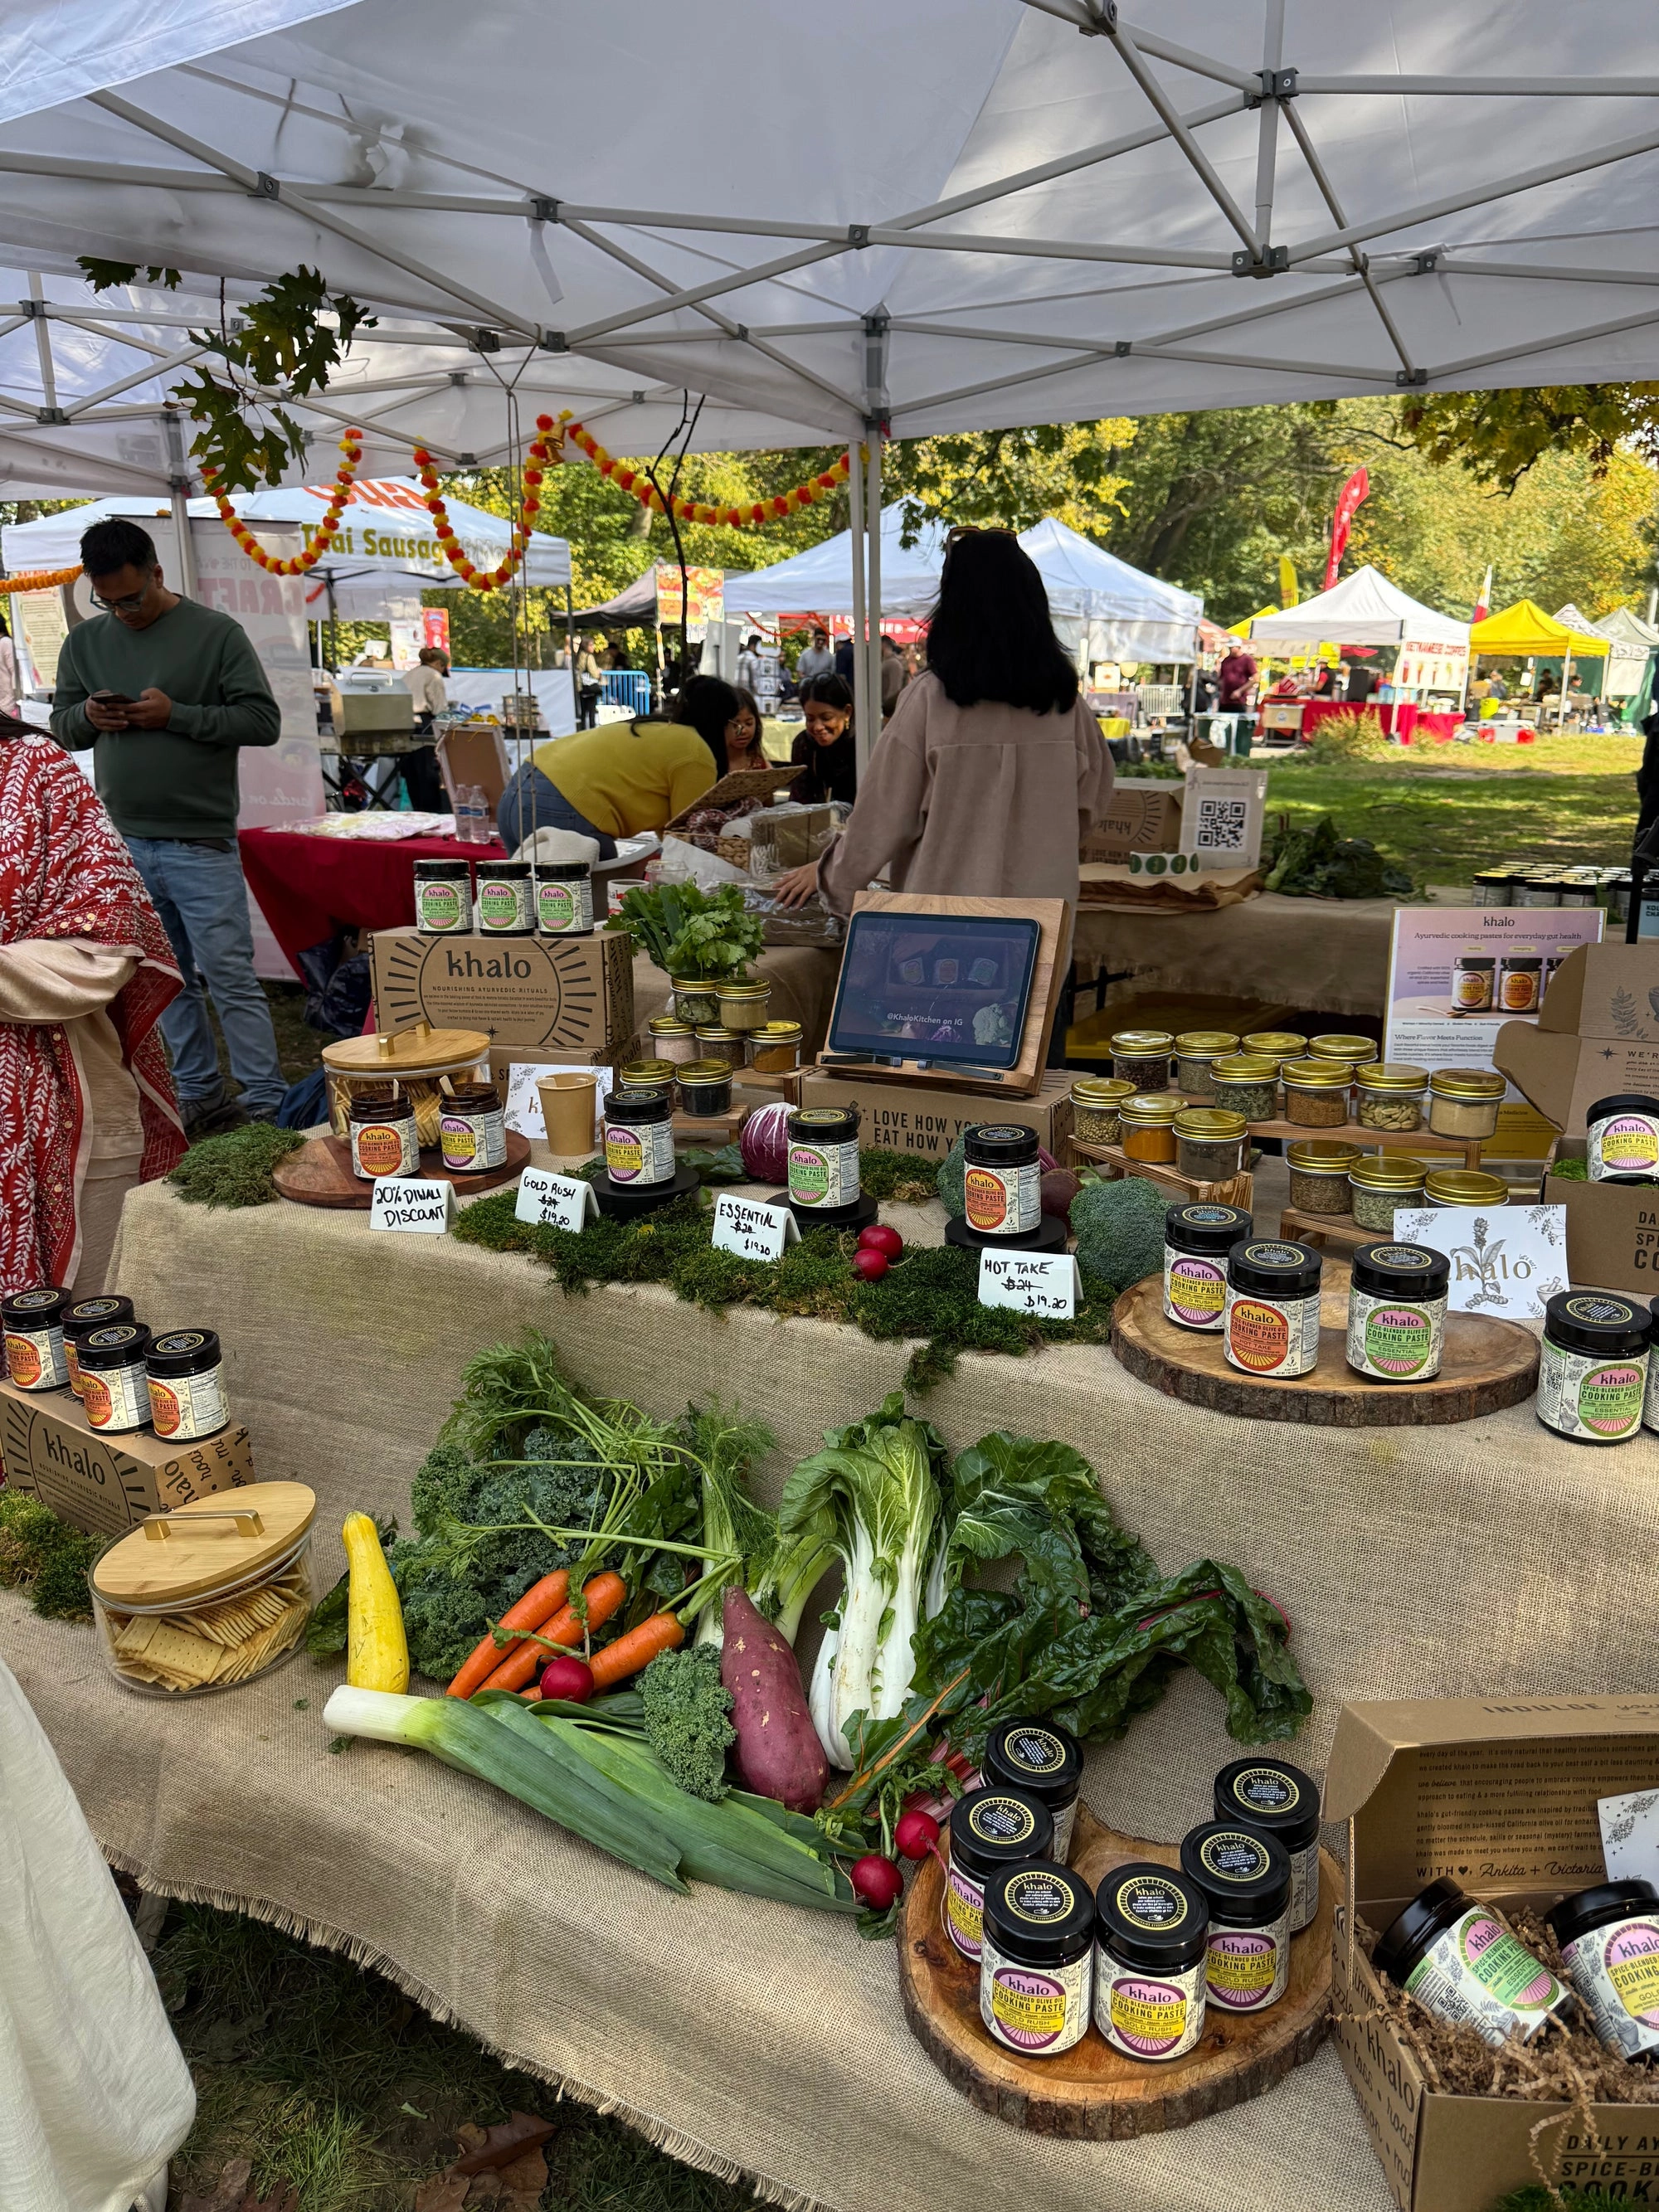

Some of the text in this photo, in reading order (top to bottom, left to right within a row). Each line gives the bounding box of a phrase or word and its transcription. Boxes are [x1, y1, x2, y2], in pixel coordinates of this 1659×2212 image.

[301, 523, 353, 554] Tai
[364, 528, 445, 566] Sausag
[487, 888, 508, 897] khalo
[1483, 916, 1515, 927] khalo
[445, 950, 532, 979] khalo
[887, 1012, 941, 1024] @KhaloKitchen
[954, 1018, 963, 1026] IG
[873, 1109, 947, 1133] LOVE HOW
[1613, 1124, 1646, 1133] khalo
[610, 1134, 630, 1144] khalo
[874, 1127, 899, 1145] EAT
[907, 1132, 938, 1151] HOW
[1603, 1137, 1656, 1148] COOKING PASTE
[794, 1153, 817, 1164] khalo
[523, 1175, 577, 1200] GOLD RUSH
[971, 1176, 994, 1189] khalo
[375, 1186, 442, 1205] 20% DIWALI
[384, 1204, 445, 1227] DISCOUNT
[539, 1208, 570, 1226] $19.20
[719, 1203, 778, 1229] ESSENTIAL
[743, 1238, 770, 1255] $19.20
[984, 1259, 1053, 1275] HOT TAKE
[1181, 1265, 1212, 1279] khalo
[1447, 1253, 1531, 1281] halo
[1171, 1278, 1198, 1292] COOKING
[1024, 1295, 1067, 1309] $19.20
[1241, 1307, 1274, 1324] khalo
[1382, 1313, 1419, 1327] khalo
[1231, 1320, 1287, 1339] COOKING PASTE
[1367, 1328, 1428, 1342] COOKING PASTE
[1600, 1373, 1636, 1385] khalo
[1581, 1388, 1642, 1401] COOKING PASTE
[42, 1427, 105, 1485] khalo
[1482, 1703, 1607, 1714] INDULGE
[1037, 1738, 1054, 1757] khalo
[1535, 1788, 1572, 1797] relationship
[996, 1805, 1022, 1821] khalo
[1216, 1842, 1245, 1852] khalo
[1416, 1865, 1453, 1878] WITH
[1479, 1863, 1526, 1877] Ankita
[1135, 1888, 1165, 1896] khalo
[1468, 1923, 1501, 1952] khalo
[1222, 1940, 1263, 1954] khalo
[1250, 1956, 1275, 1970] PASTE
[1472, 1942, 1506, 1974] SPICE-BLENDED
[1479, 1947, 1511, 1983] COOKING
[1506, 1959, 1535, 1986] ESSENTIAL
[1610, 1957, 1657, 1976] SPICE-BLENDED
[1218, 1974, 1240, 1983] GOLD
[1613, 1965, 1659, 1989] COOKING
[995, 1981, 1035, 2003] SPICE-BLENDED
[1008, 1976, 1050, 1996] khalo
[994, 1986, 1063, 2012] COOKING PASTE
[1113, 1991, 1156, 2010] SPICE-BLENDED
[1129, 1986, 1171, 2003] khalo
[1112, 1996, 1185, 2020] COOKING PASTE
[1004, 2010, 1024, 2023] GOLD
[1124, 2019, 1146, 2030] GOLD
[1366, 2020, 1414, 2112] khalo
